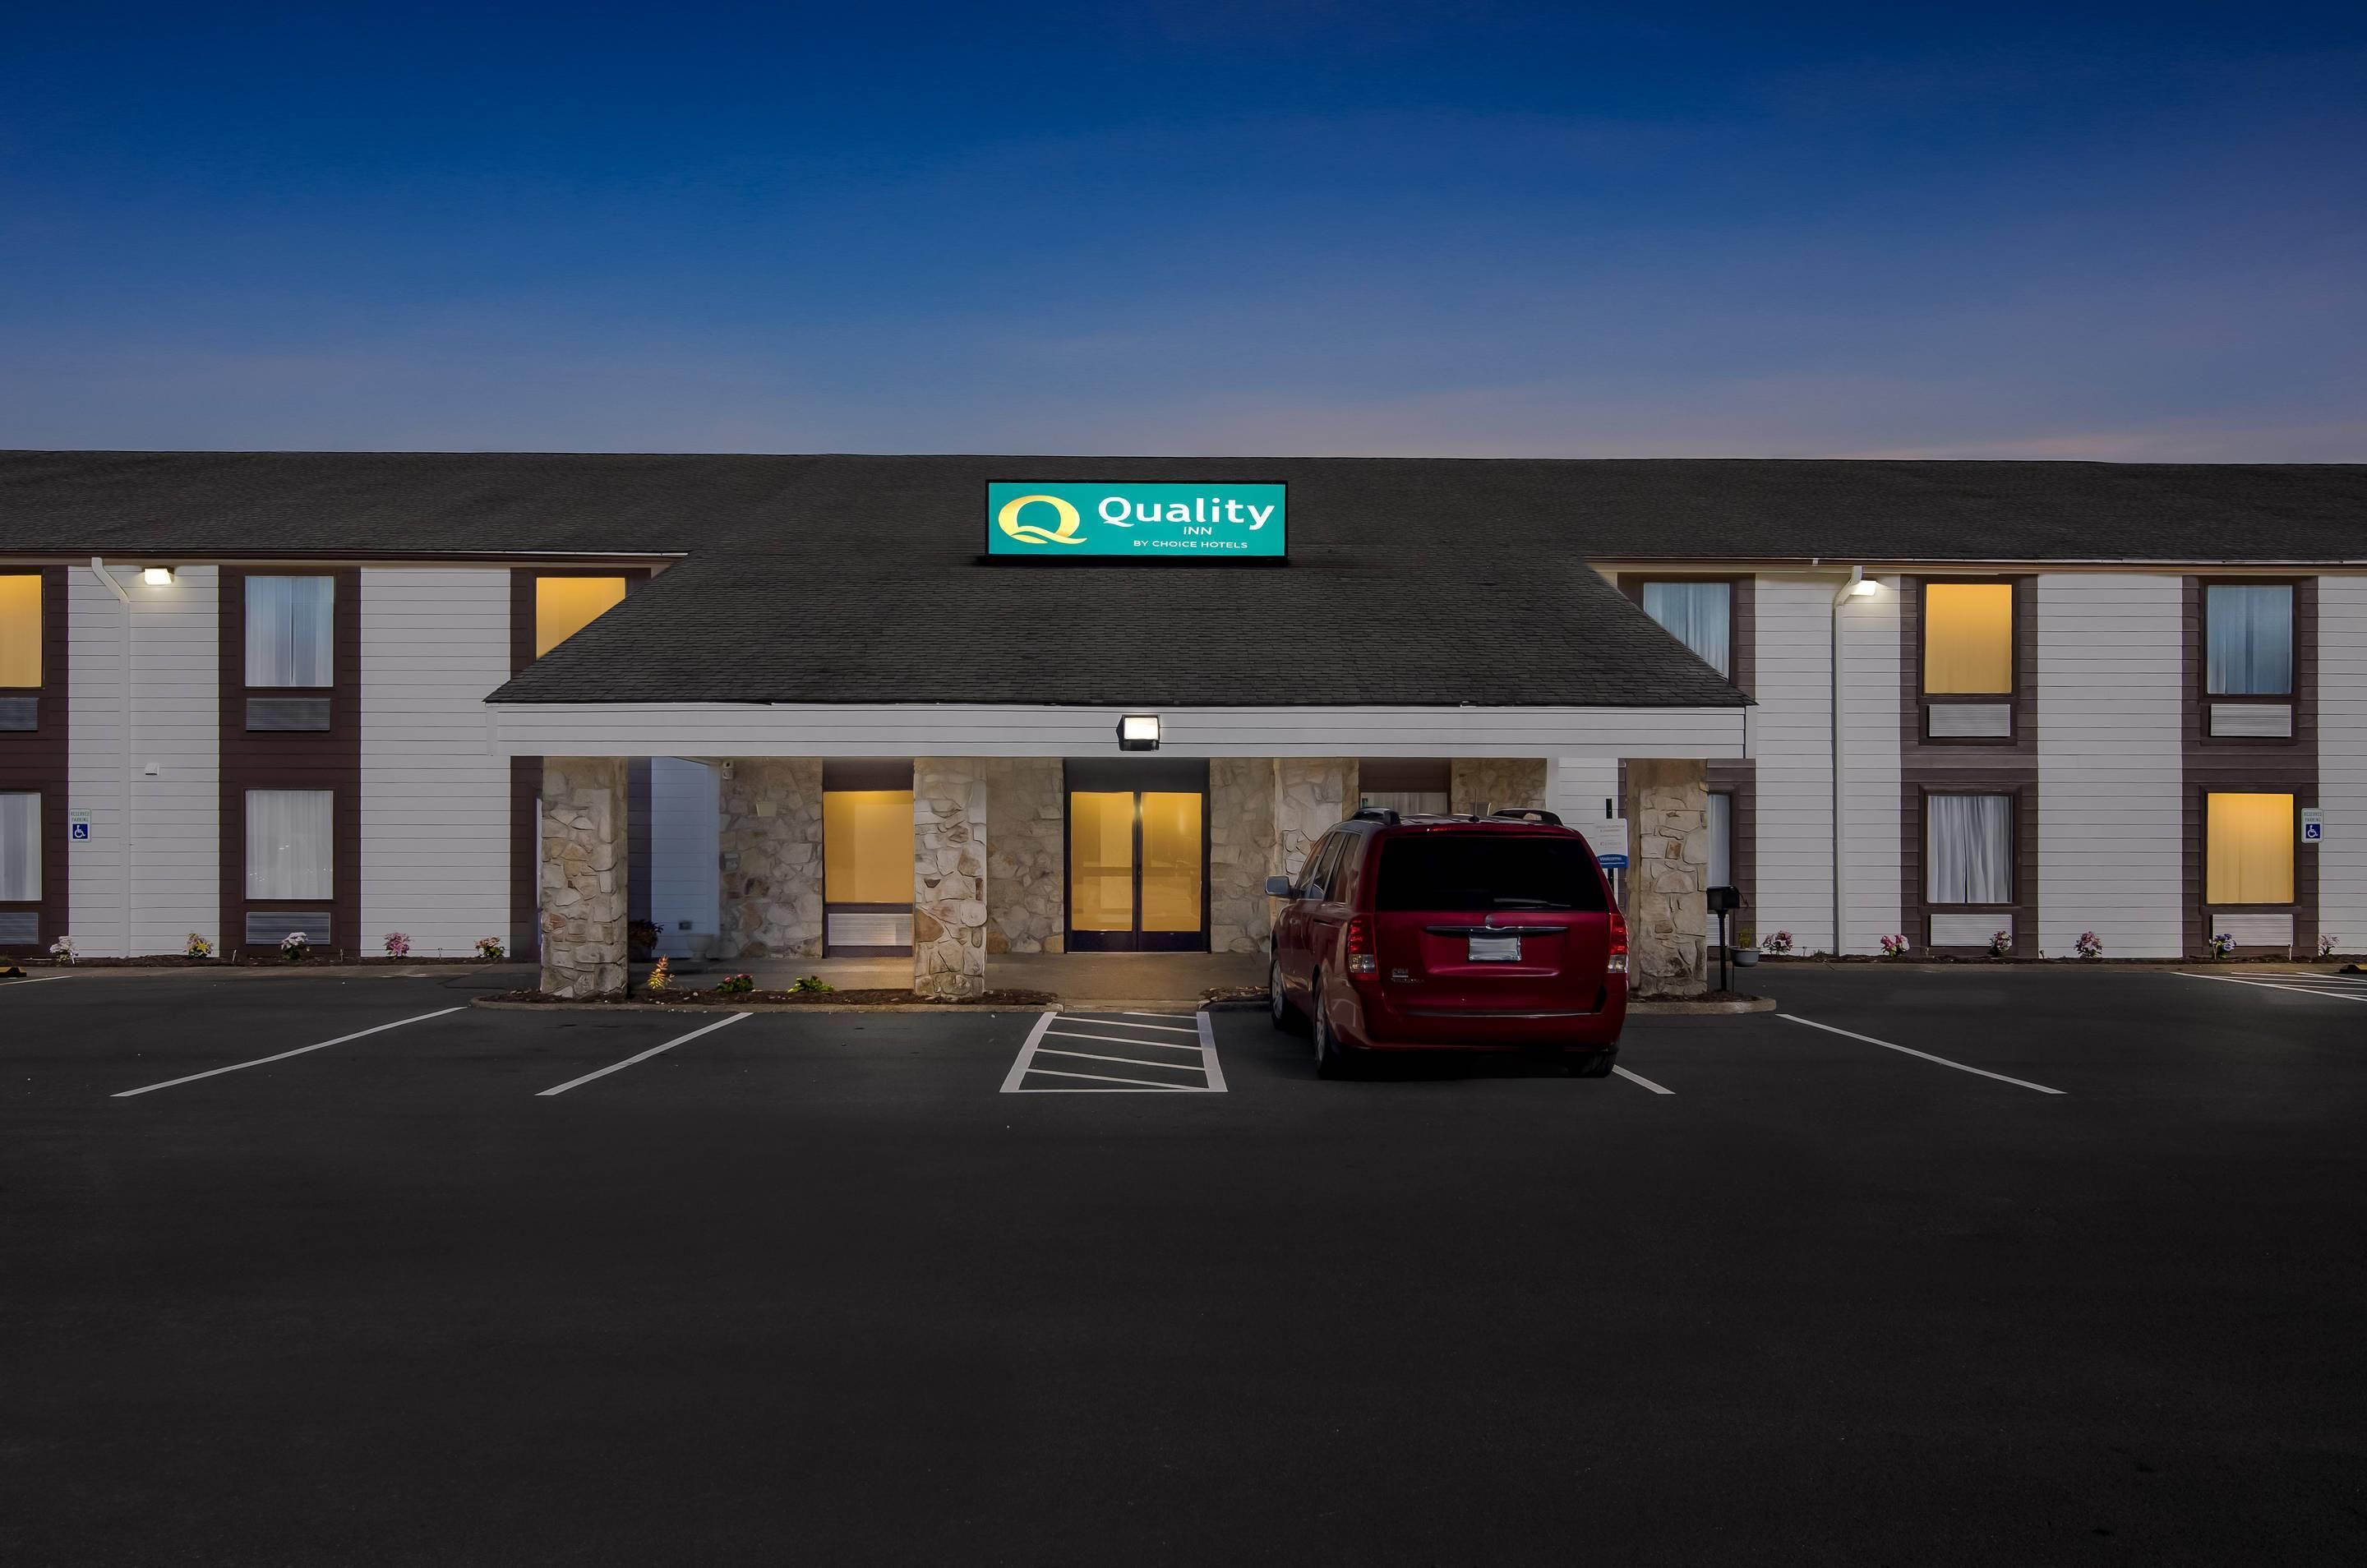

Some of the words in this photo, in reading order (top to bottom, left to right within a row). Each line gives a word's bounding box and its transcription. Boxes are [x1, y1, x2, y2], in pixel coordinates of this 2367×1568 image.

[998, 495, 1087, 544] Q
[1098, 496, 1275, 530] Quality
[1184, 527, 1212, 535] INN
